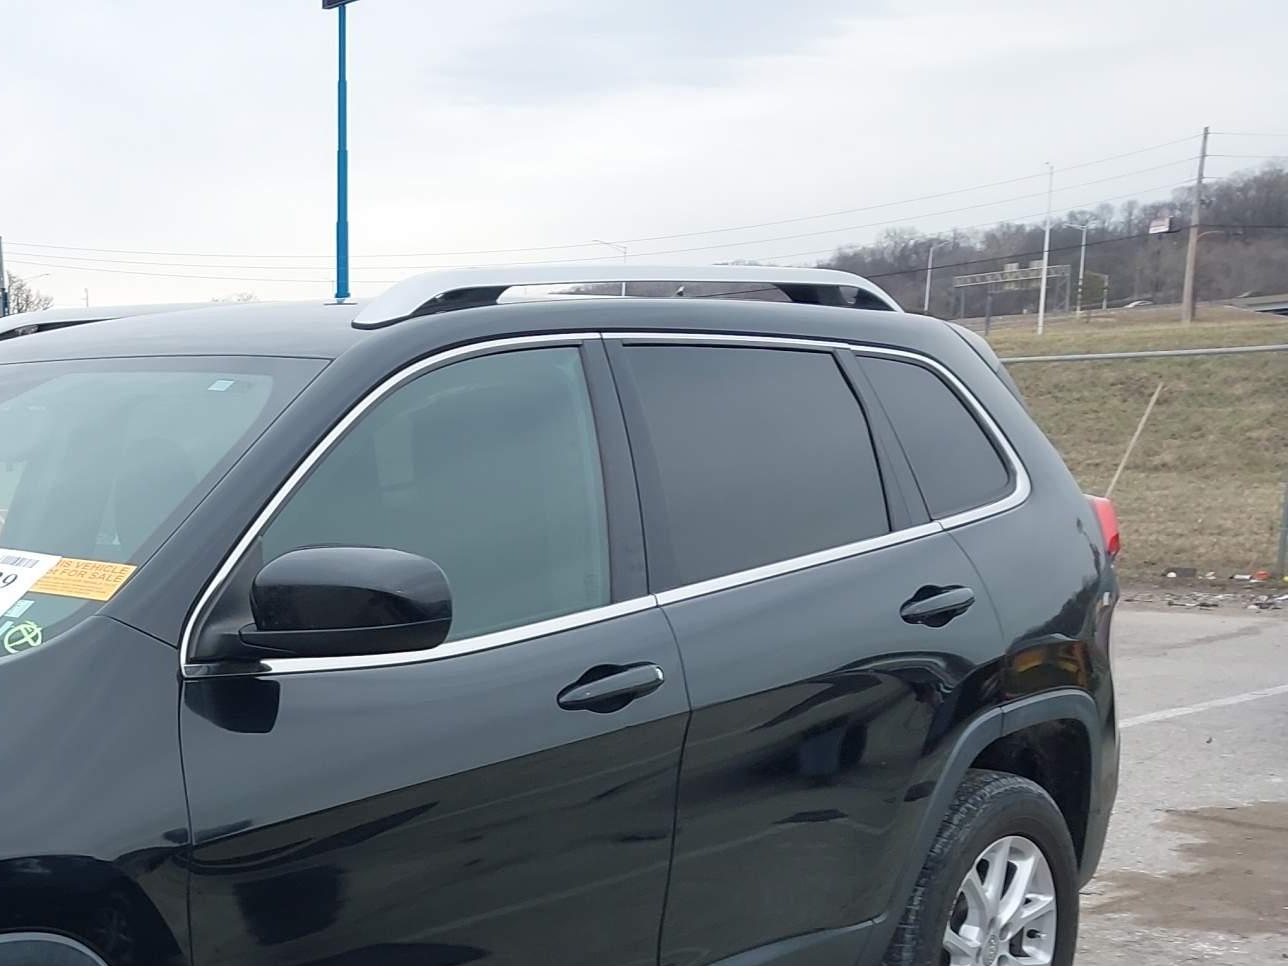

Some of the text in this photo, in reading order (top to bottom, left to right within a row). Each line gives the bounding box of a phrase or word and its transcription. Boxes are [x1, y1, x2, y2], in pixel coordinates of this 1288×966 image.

[75, 561, 129, 575] VEHICLE
[59, 569, 85, 578] FOR
[88, 571, 124, 583] SALE
